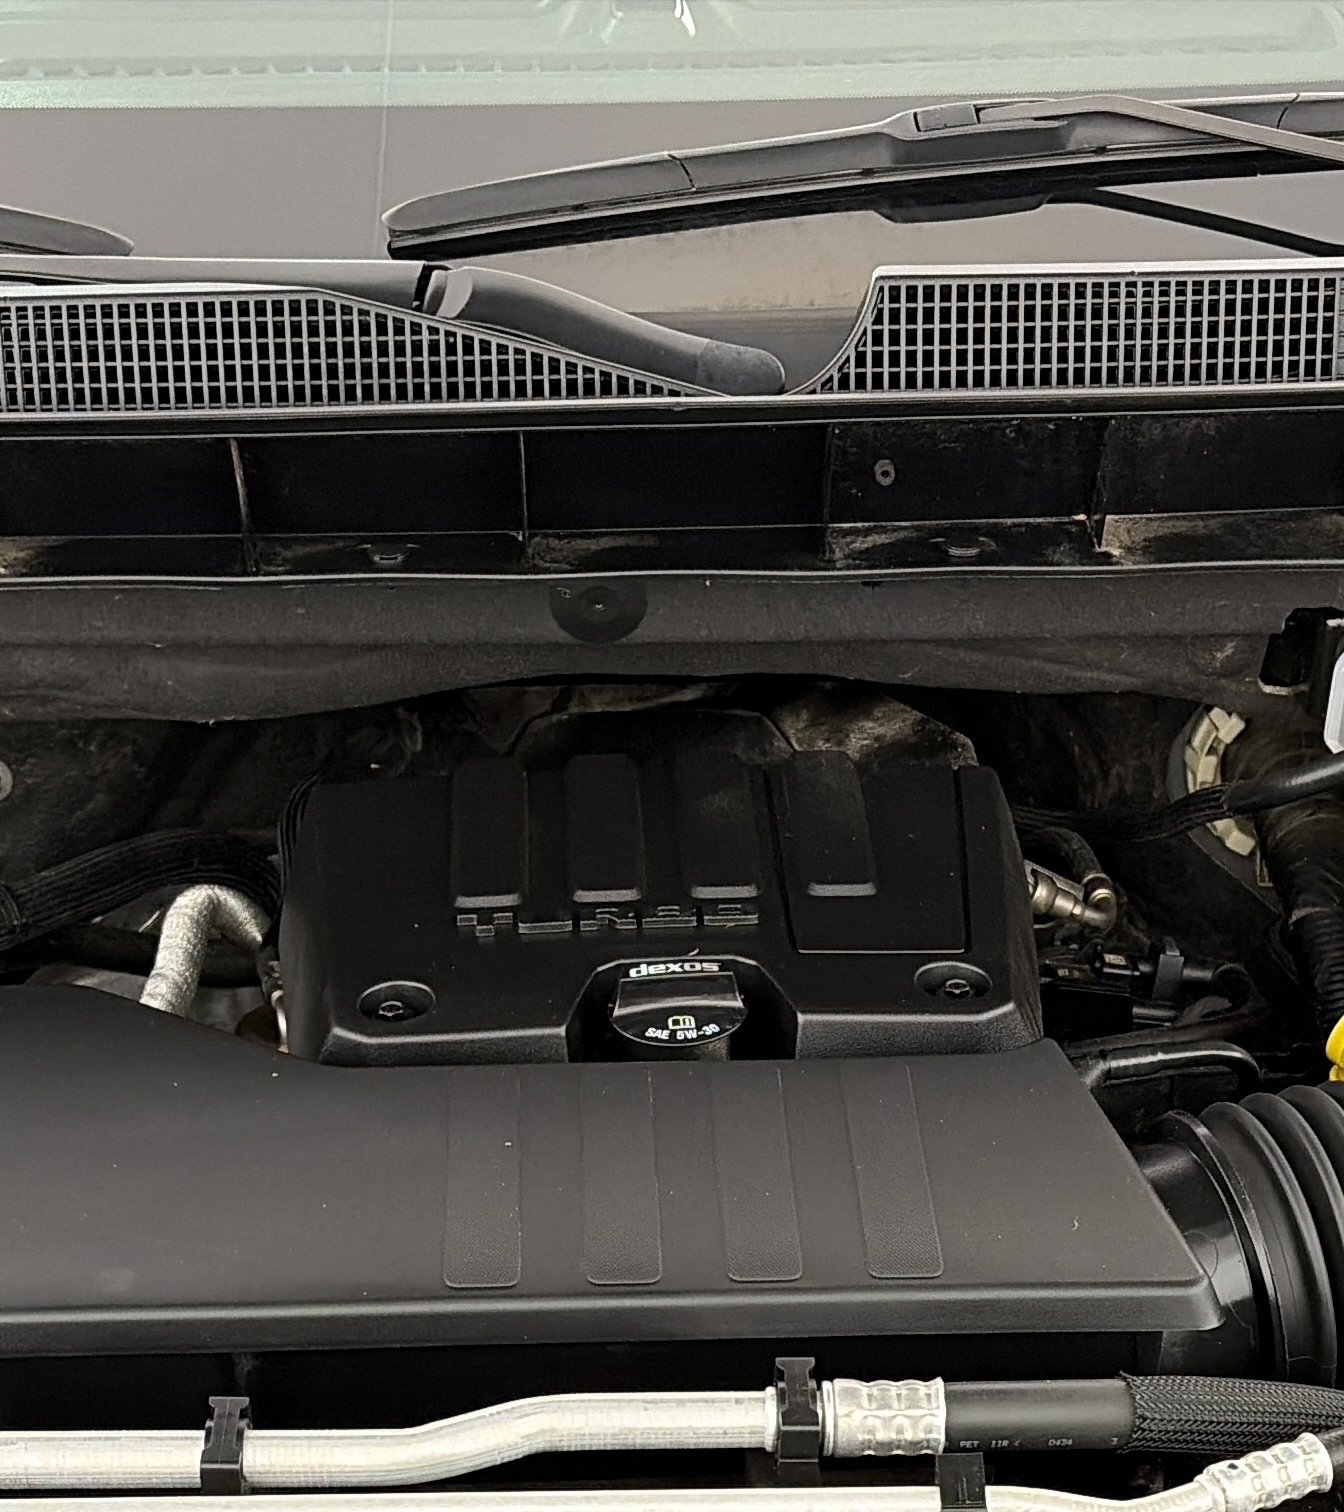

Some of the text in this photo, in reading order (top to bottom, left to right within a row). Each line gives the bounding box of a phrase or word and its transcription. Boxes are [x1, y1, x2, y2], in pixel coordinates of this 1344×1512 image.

[628, 961, 722, 978] dexos
[644, 1023, 721, 1040] SAE 5W-30
